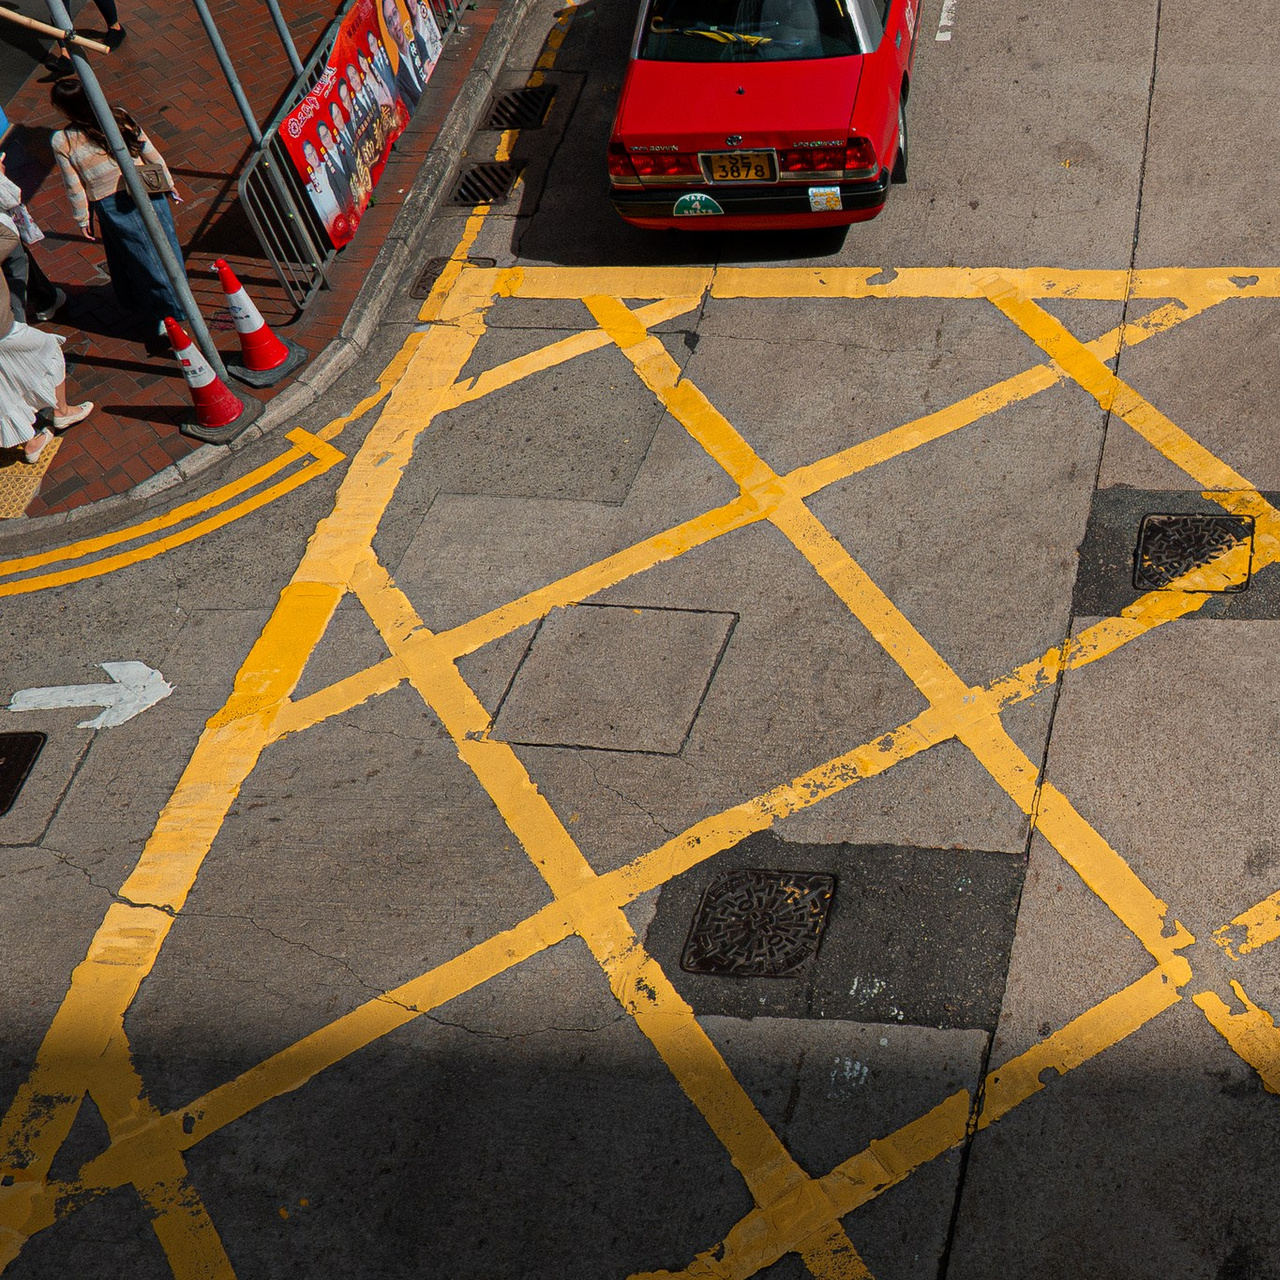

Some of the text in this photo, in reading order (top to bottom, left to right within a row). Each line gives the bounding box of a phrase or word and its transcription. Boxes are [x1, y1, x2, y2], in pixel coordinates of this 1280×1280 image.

[729, 154, 751, 165] SE
[718, 165, 765, 178] 3878
[691, 201, 701, 210] 4
